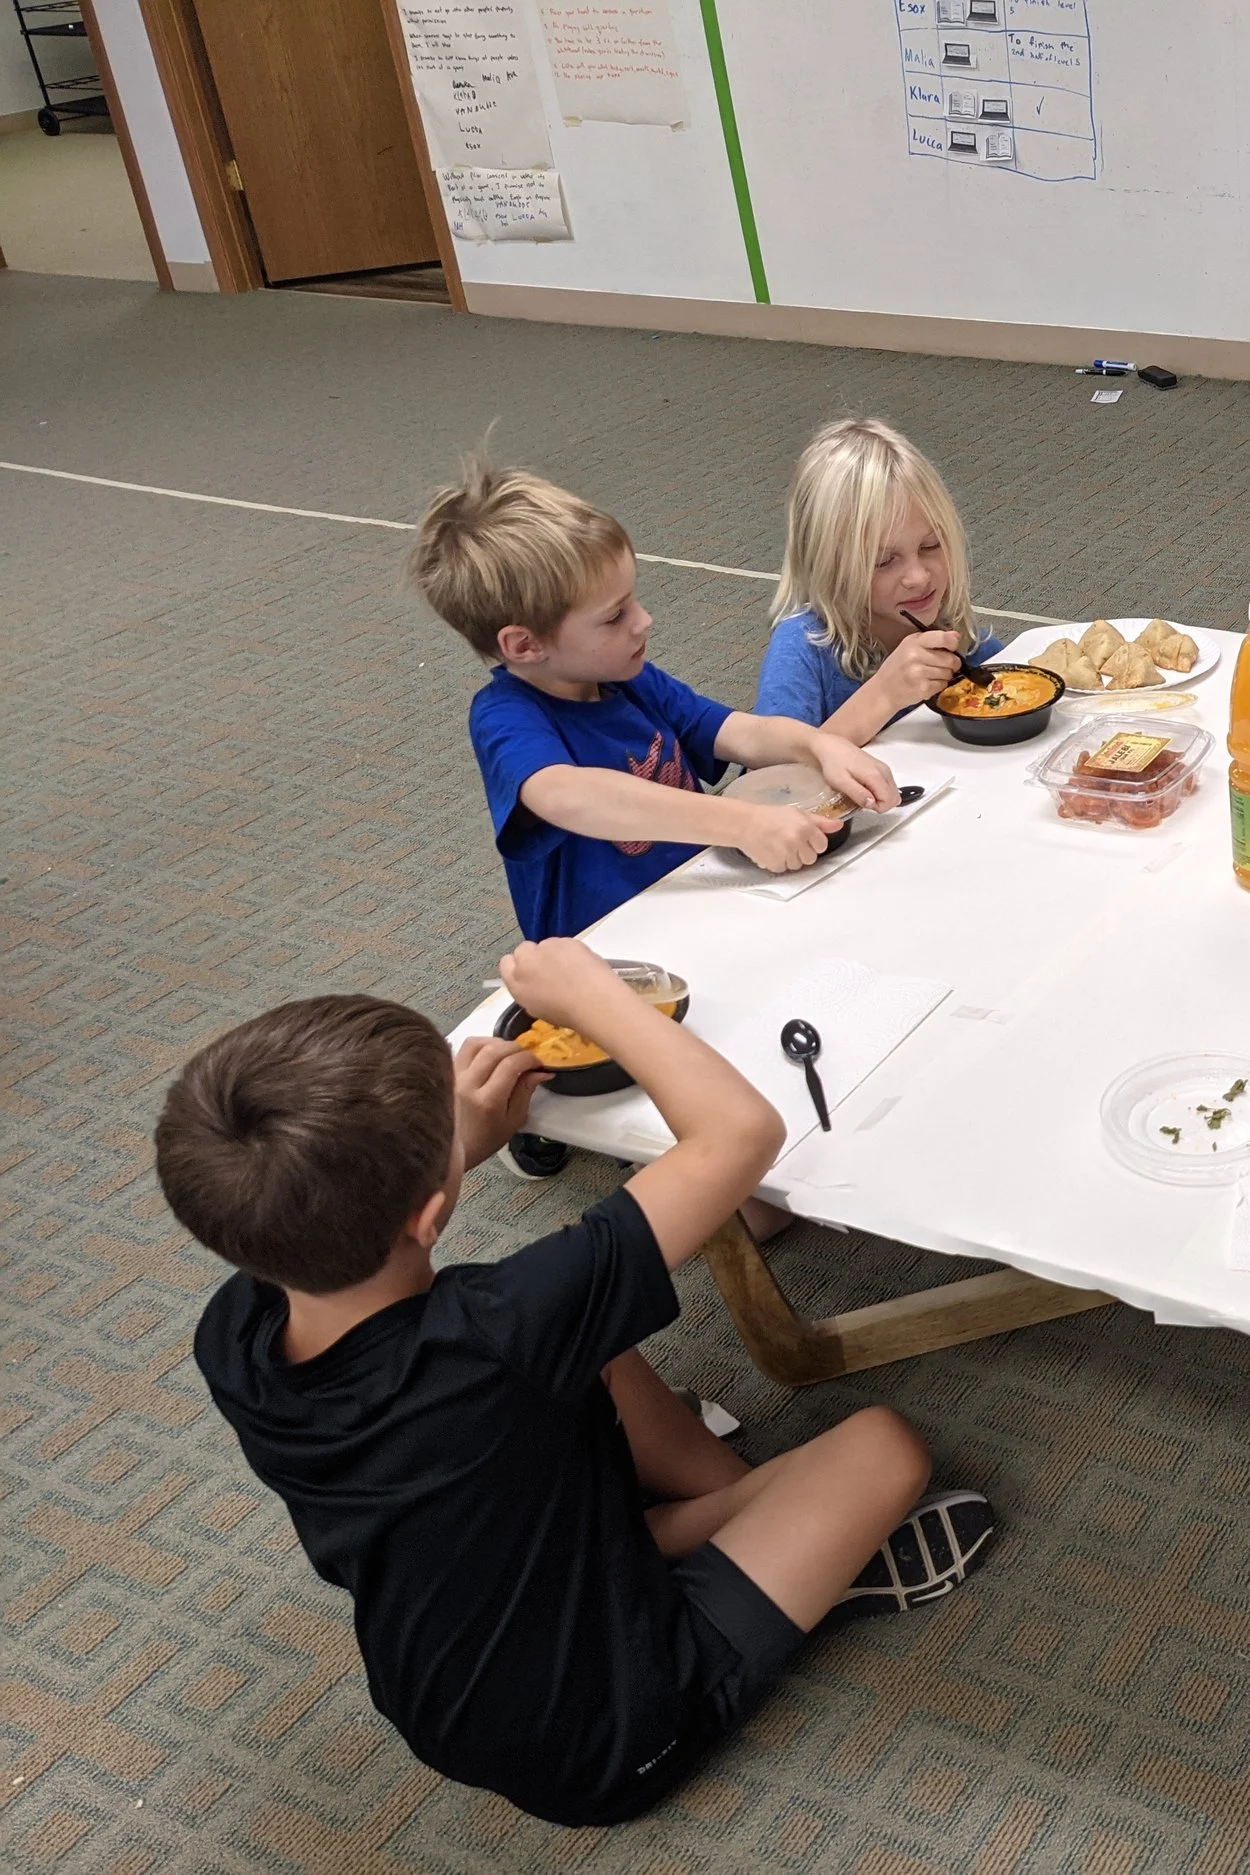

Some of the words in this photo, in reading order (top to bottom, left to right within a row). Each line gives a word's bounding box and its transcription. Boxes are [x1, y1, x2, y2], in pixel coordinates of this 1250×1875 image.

[1008, 33, 1021, 45] To
[1029, 35, 1055, 50] finish
[1060, 42, 1074, 52] the
[904, 48, 935, 68] Malia
[909, 85, 941, 104] Klara
